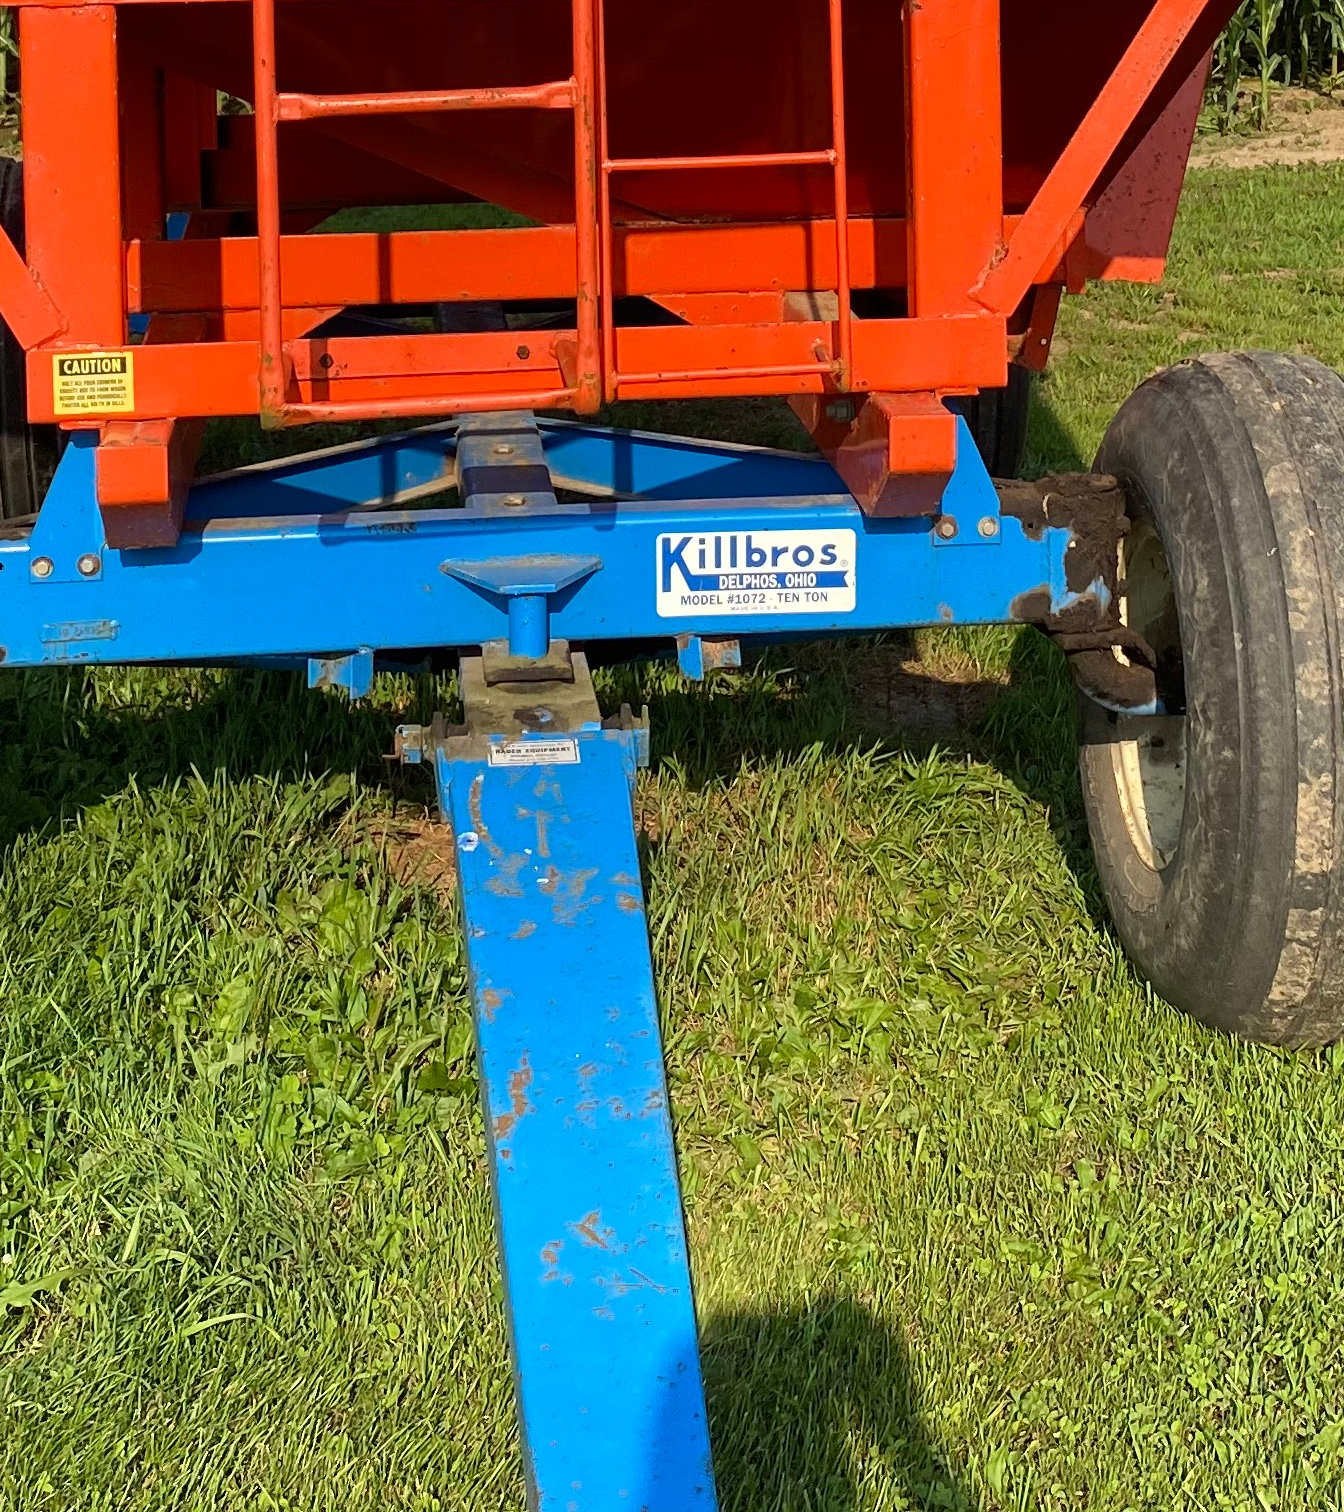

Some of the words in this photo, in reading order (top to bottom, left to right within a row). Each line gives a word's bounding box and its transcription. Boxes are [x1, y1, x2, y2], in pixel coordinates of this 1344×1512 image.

[63, 358, 122, 375] CAUTION
[662, 535, 838, 593] Killbros
[785, 572, 817, 588] OHIO
[680, 594, 723, 606] MODEL
[727, 593, 766, 605] #1072
[777, 592, 800, 604] TEN
[804, 591, 829, 603] TON
